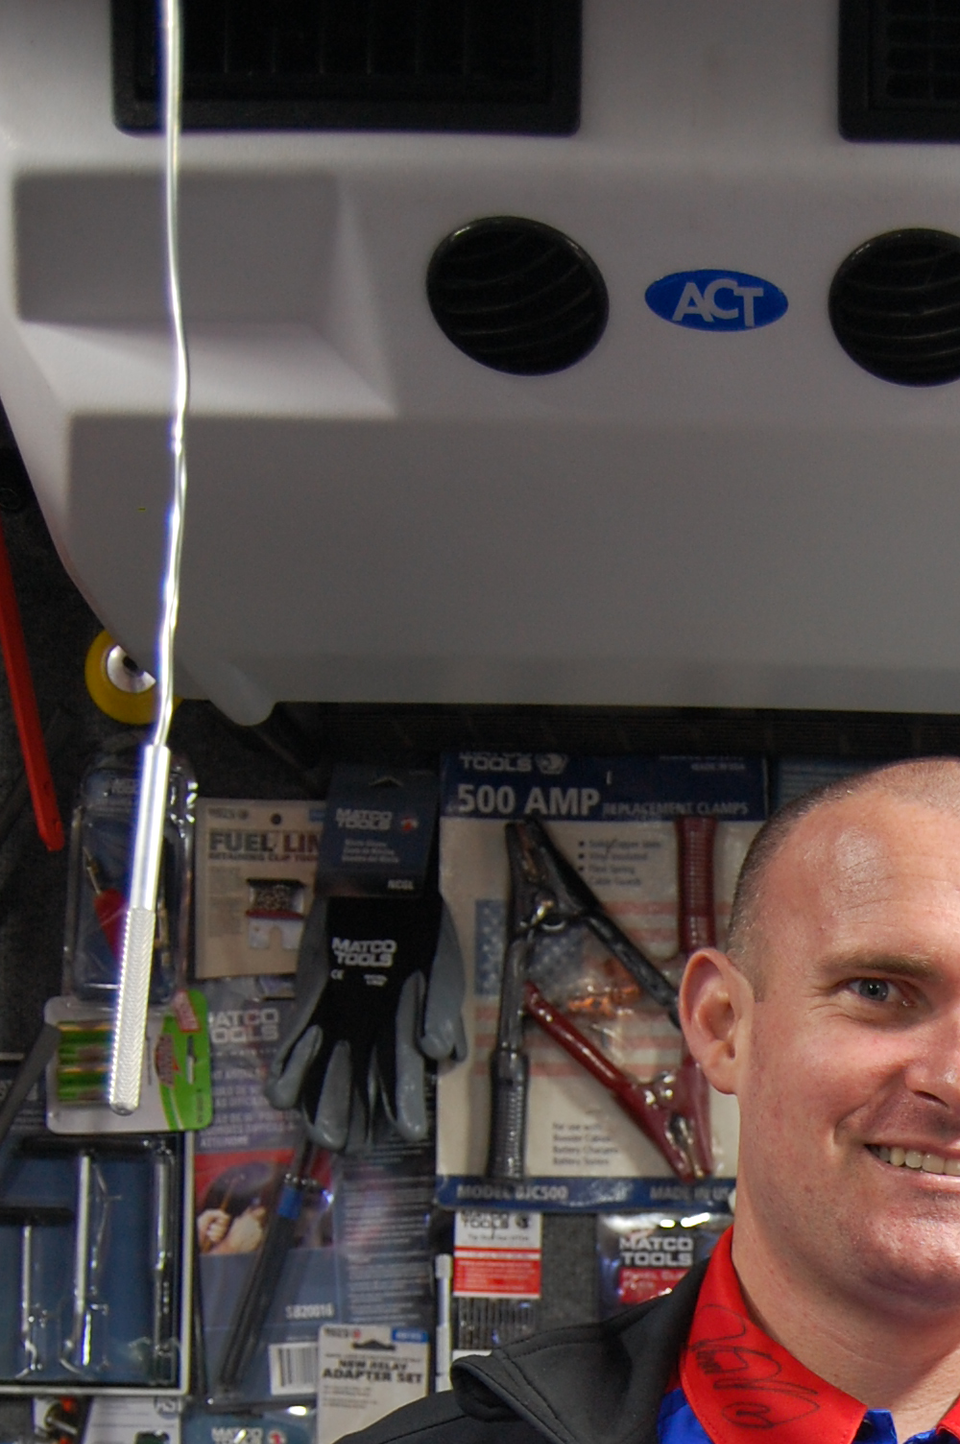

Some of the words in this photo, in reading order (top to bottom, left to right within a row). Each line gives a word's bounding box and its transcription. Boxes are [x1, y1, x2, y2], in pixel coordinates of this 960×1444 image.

[672, 278, 764, 328] ACT
[459, 754, 532, 771] TOOLS
[457, 784, 515, 815] 500
[523, 786, 600, 816] AMP
[336, 808, 393, 821] MATCO
[697, 802, 749, 816] CLAMPS
[338, 818, 391, 831] TOOLS
[210, 831, 275, 852] FUEL
[331, 937, 397, 955] MATCO
[335, 951, 393, 968] TOOLS
[456, 1184, 511, 1200] MODEL
[619, 1237, 694, 1252] MATCO
[622, 1251, 693, 1267] TOOLS
[322, 1368, 393, 1383] ADAPTER
[395, 1372, 423, 1384] SET
